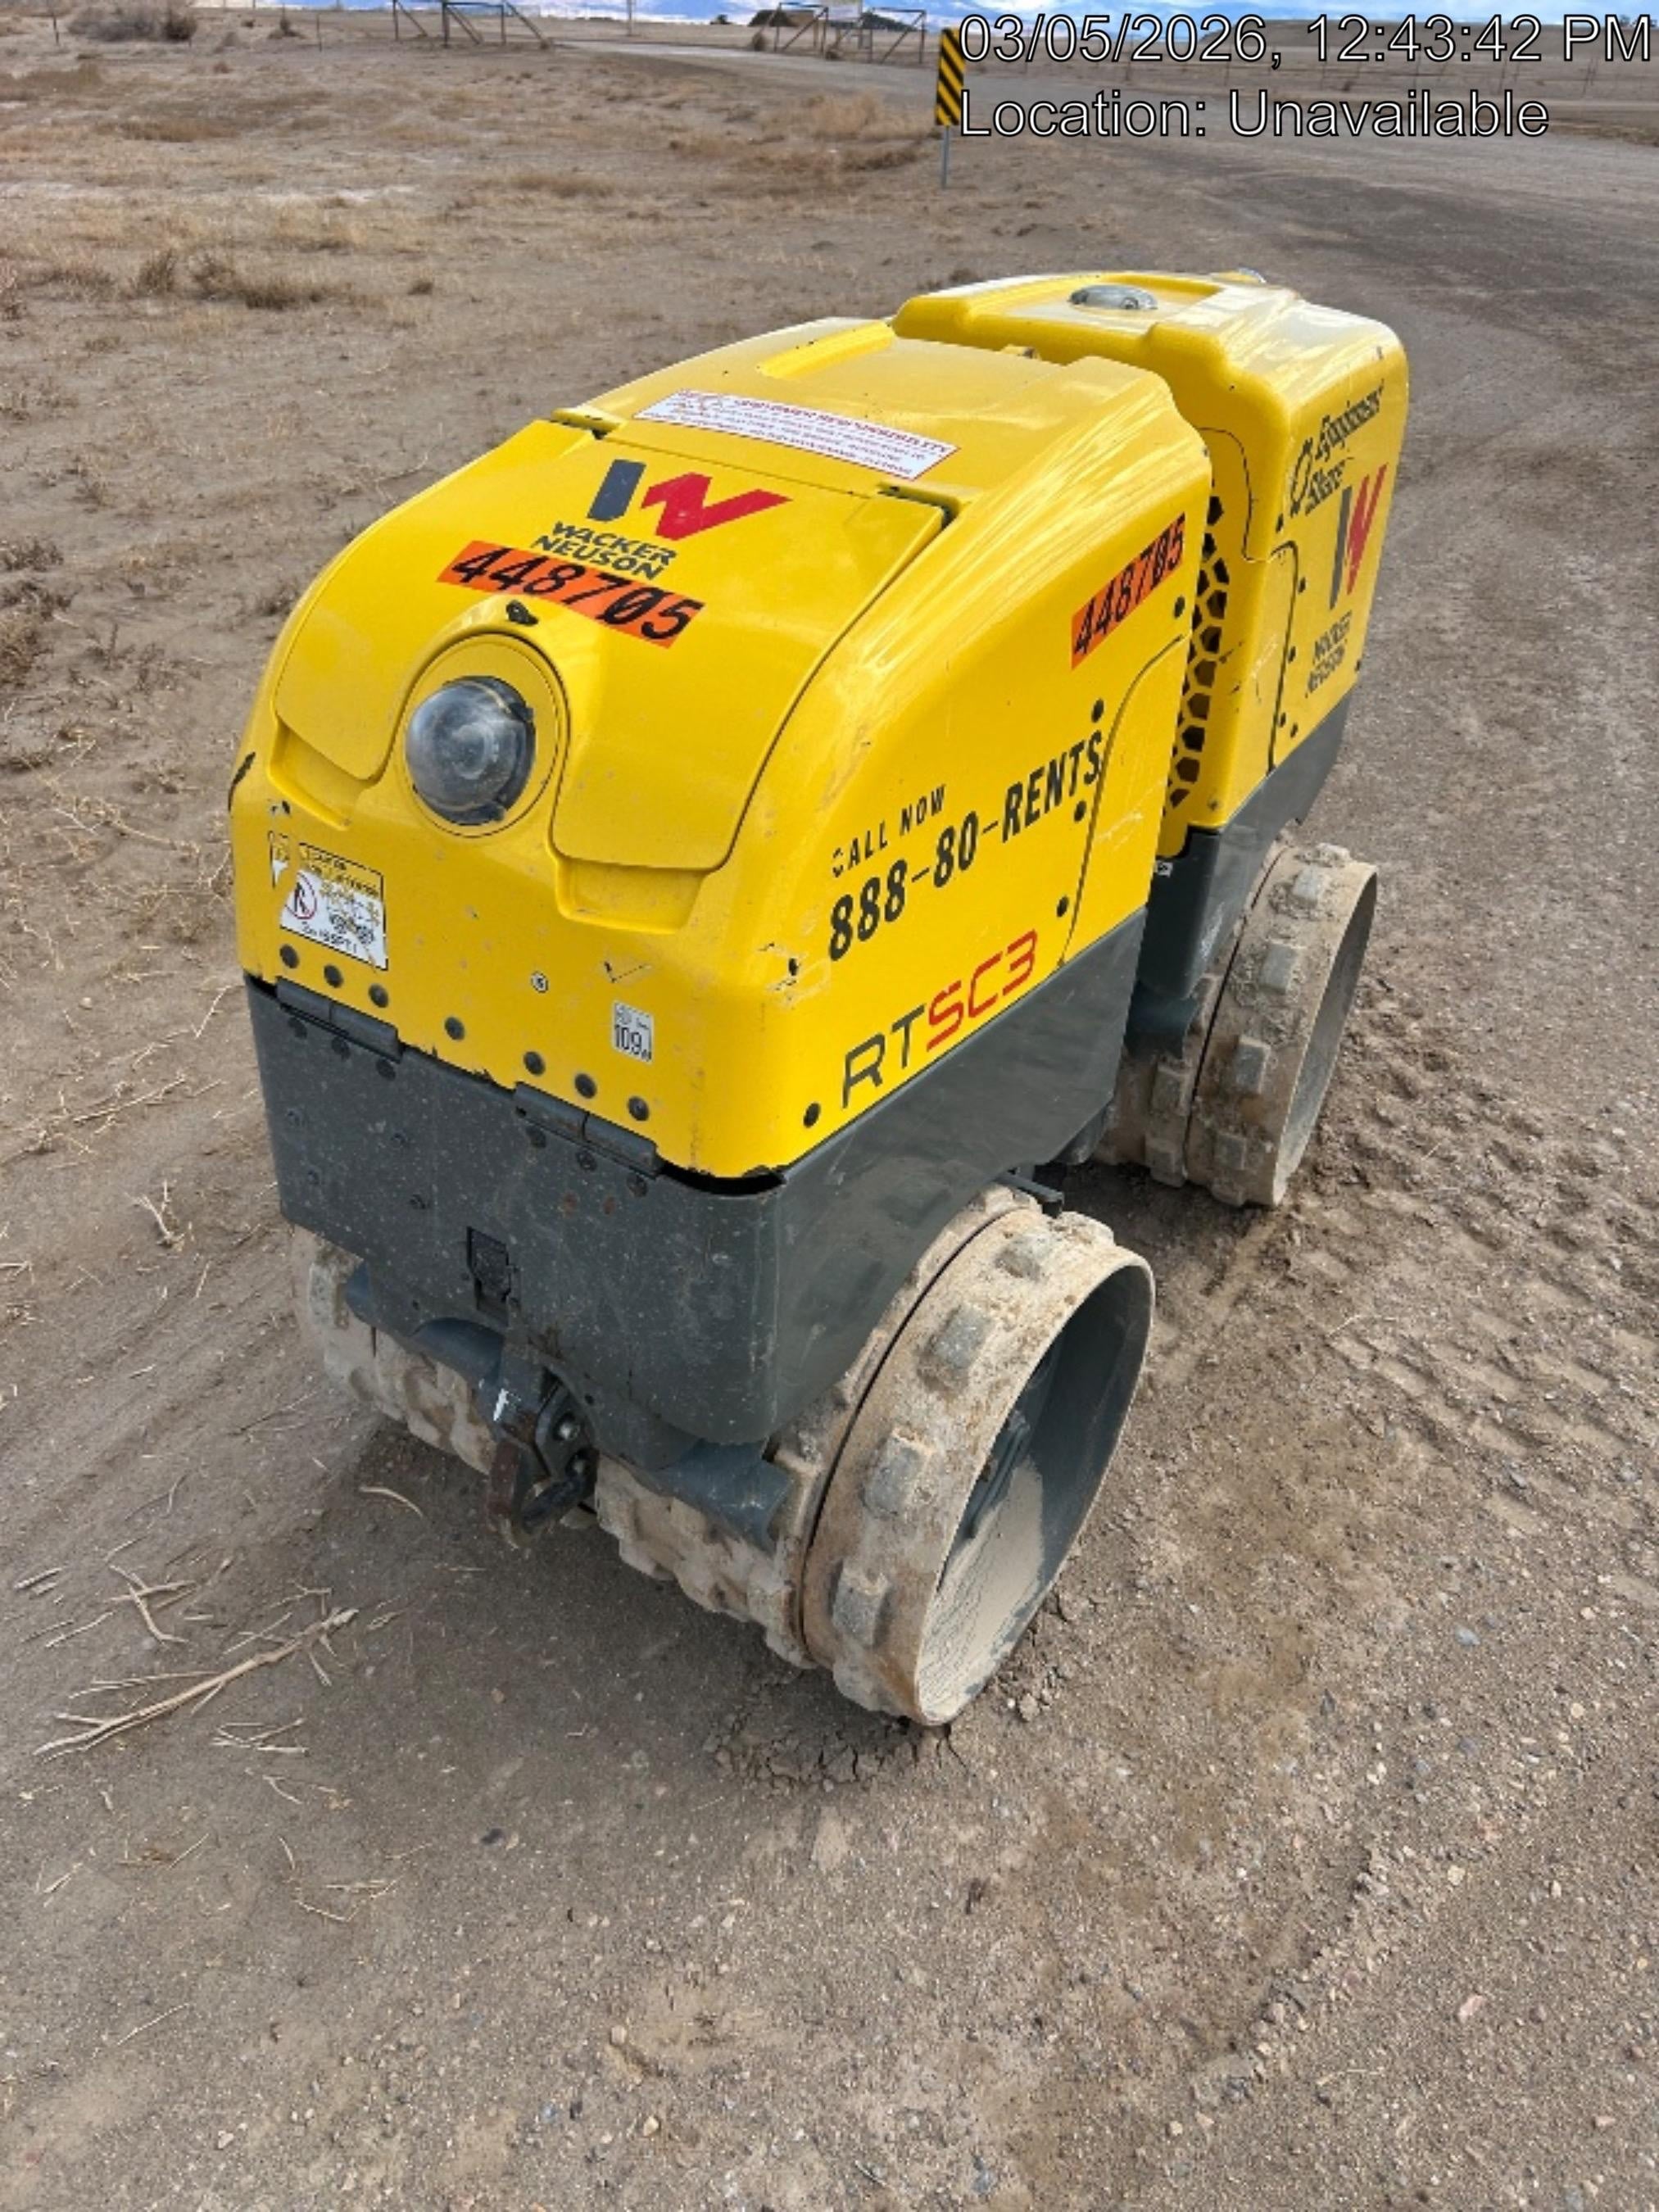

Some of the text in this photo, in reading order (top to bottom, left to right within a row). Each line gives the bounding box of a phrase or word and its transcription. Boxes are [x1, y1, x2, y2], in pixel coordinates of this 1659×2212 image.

[531, 535, 664, 580] NEUSON
[553, 521, 677, 566] WACKER
[1074, 511, 1185, 654] 448705
[452, 547, 705, 641] 448705
[828, 729, 1103, 961] 888-80-RENTS
[900, 784, 945, 836] NOW
[842, 929, 1037, 1108] RTSC3
